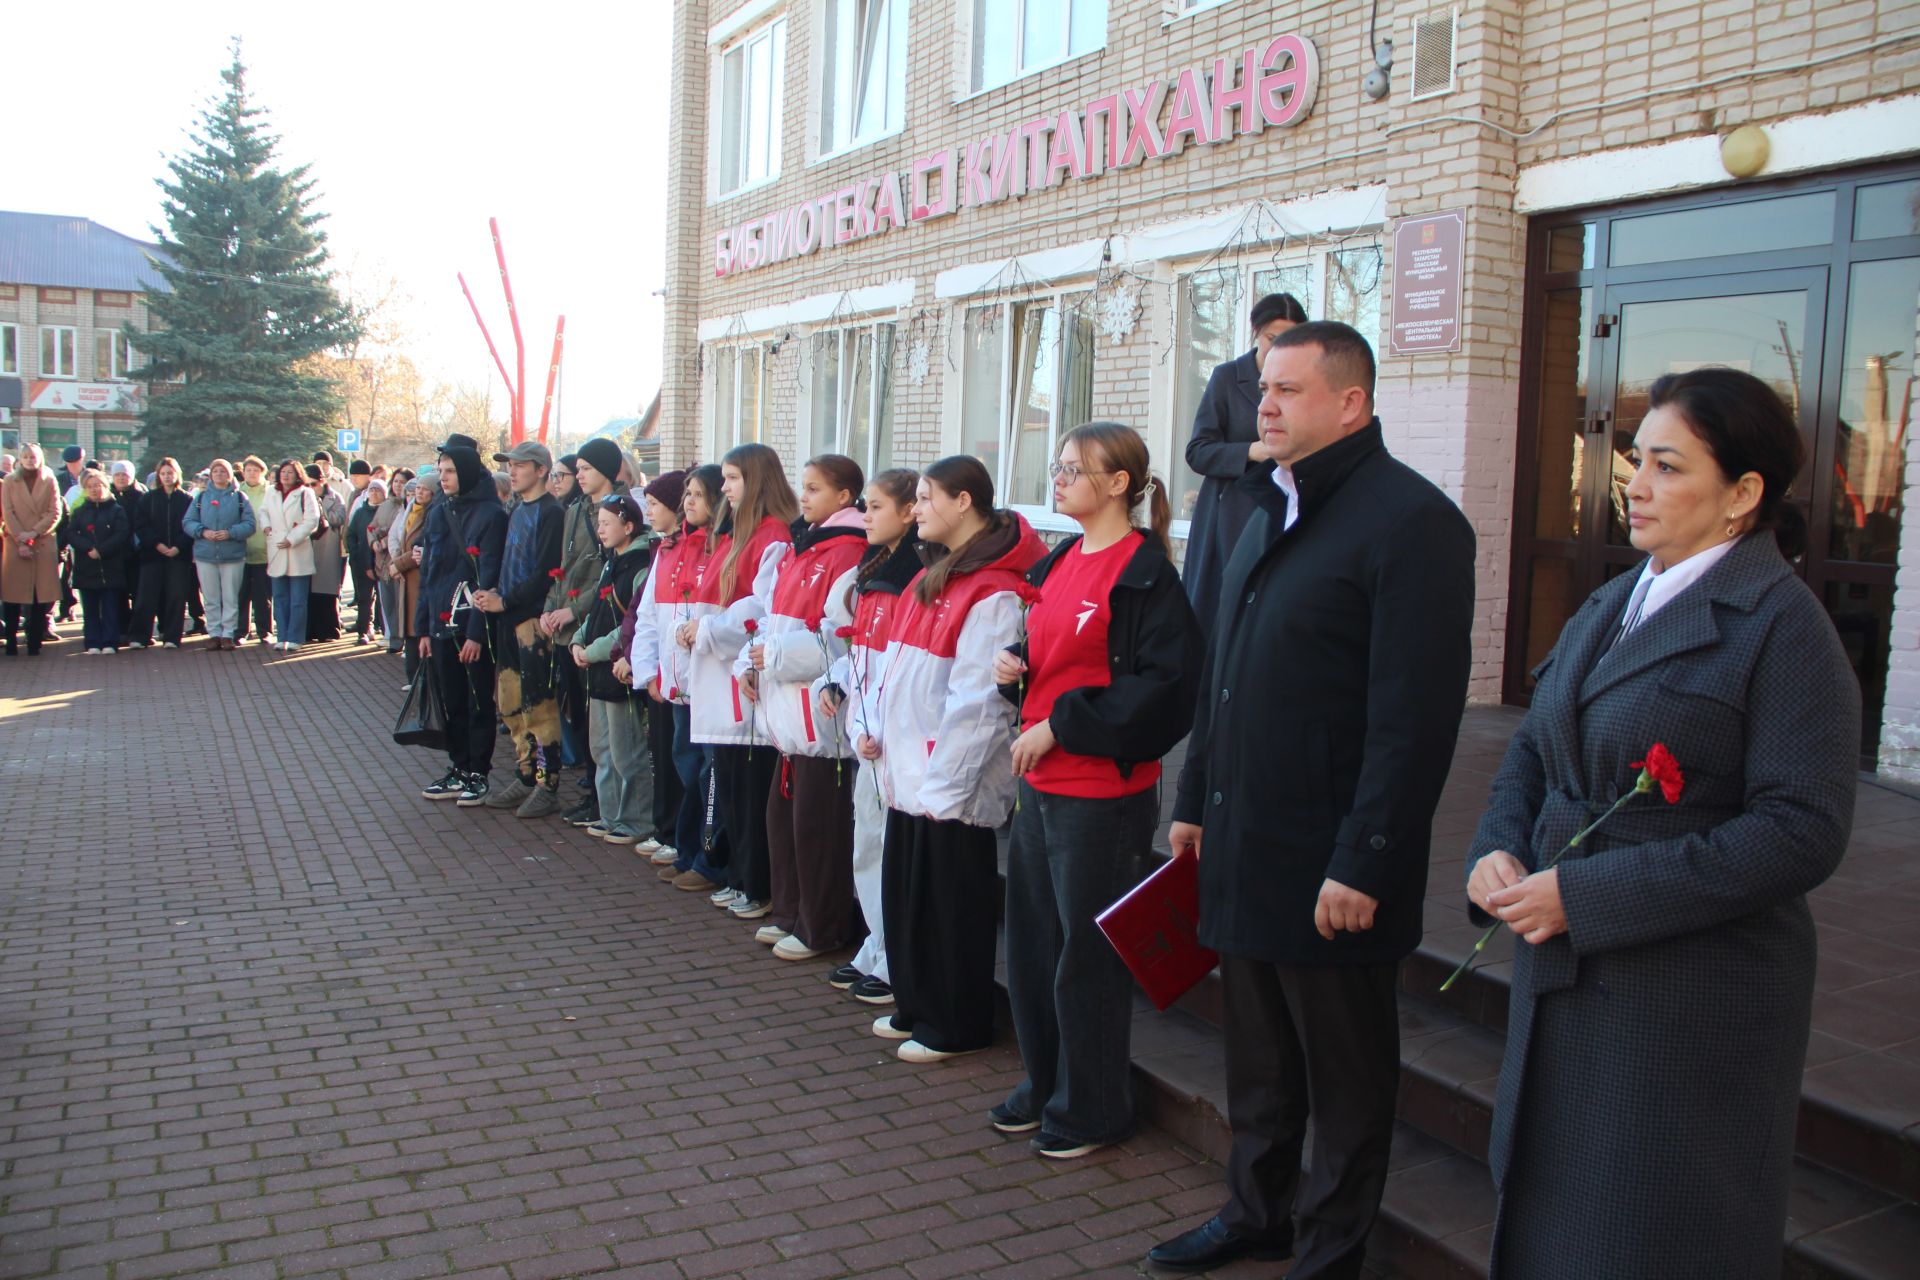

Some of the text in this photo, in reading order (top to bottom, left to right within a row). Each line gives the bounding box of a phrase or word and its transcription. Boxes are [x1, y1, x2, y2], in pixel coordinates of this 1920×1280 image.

[715, 34, 1320, 278] БИБЛИОТЕКА КИТАПХАНӘ
[343, 431, 356, 450] P
